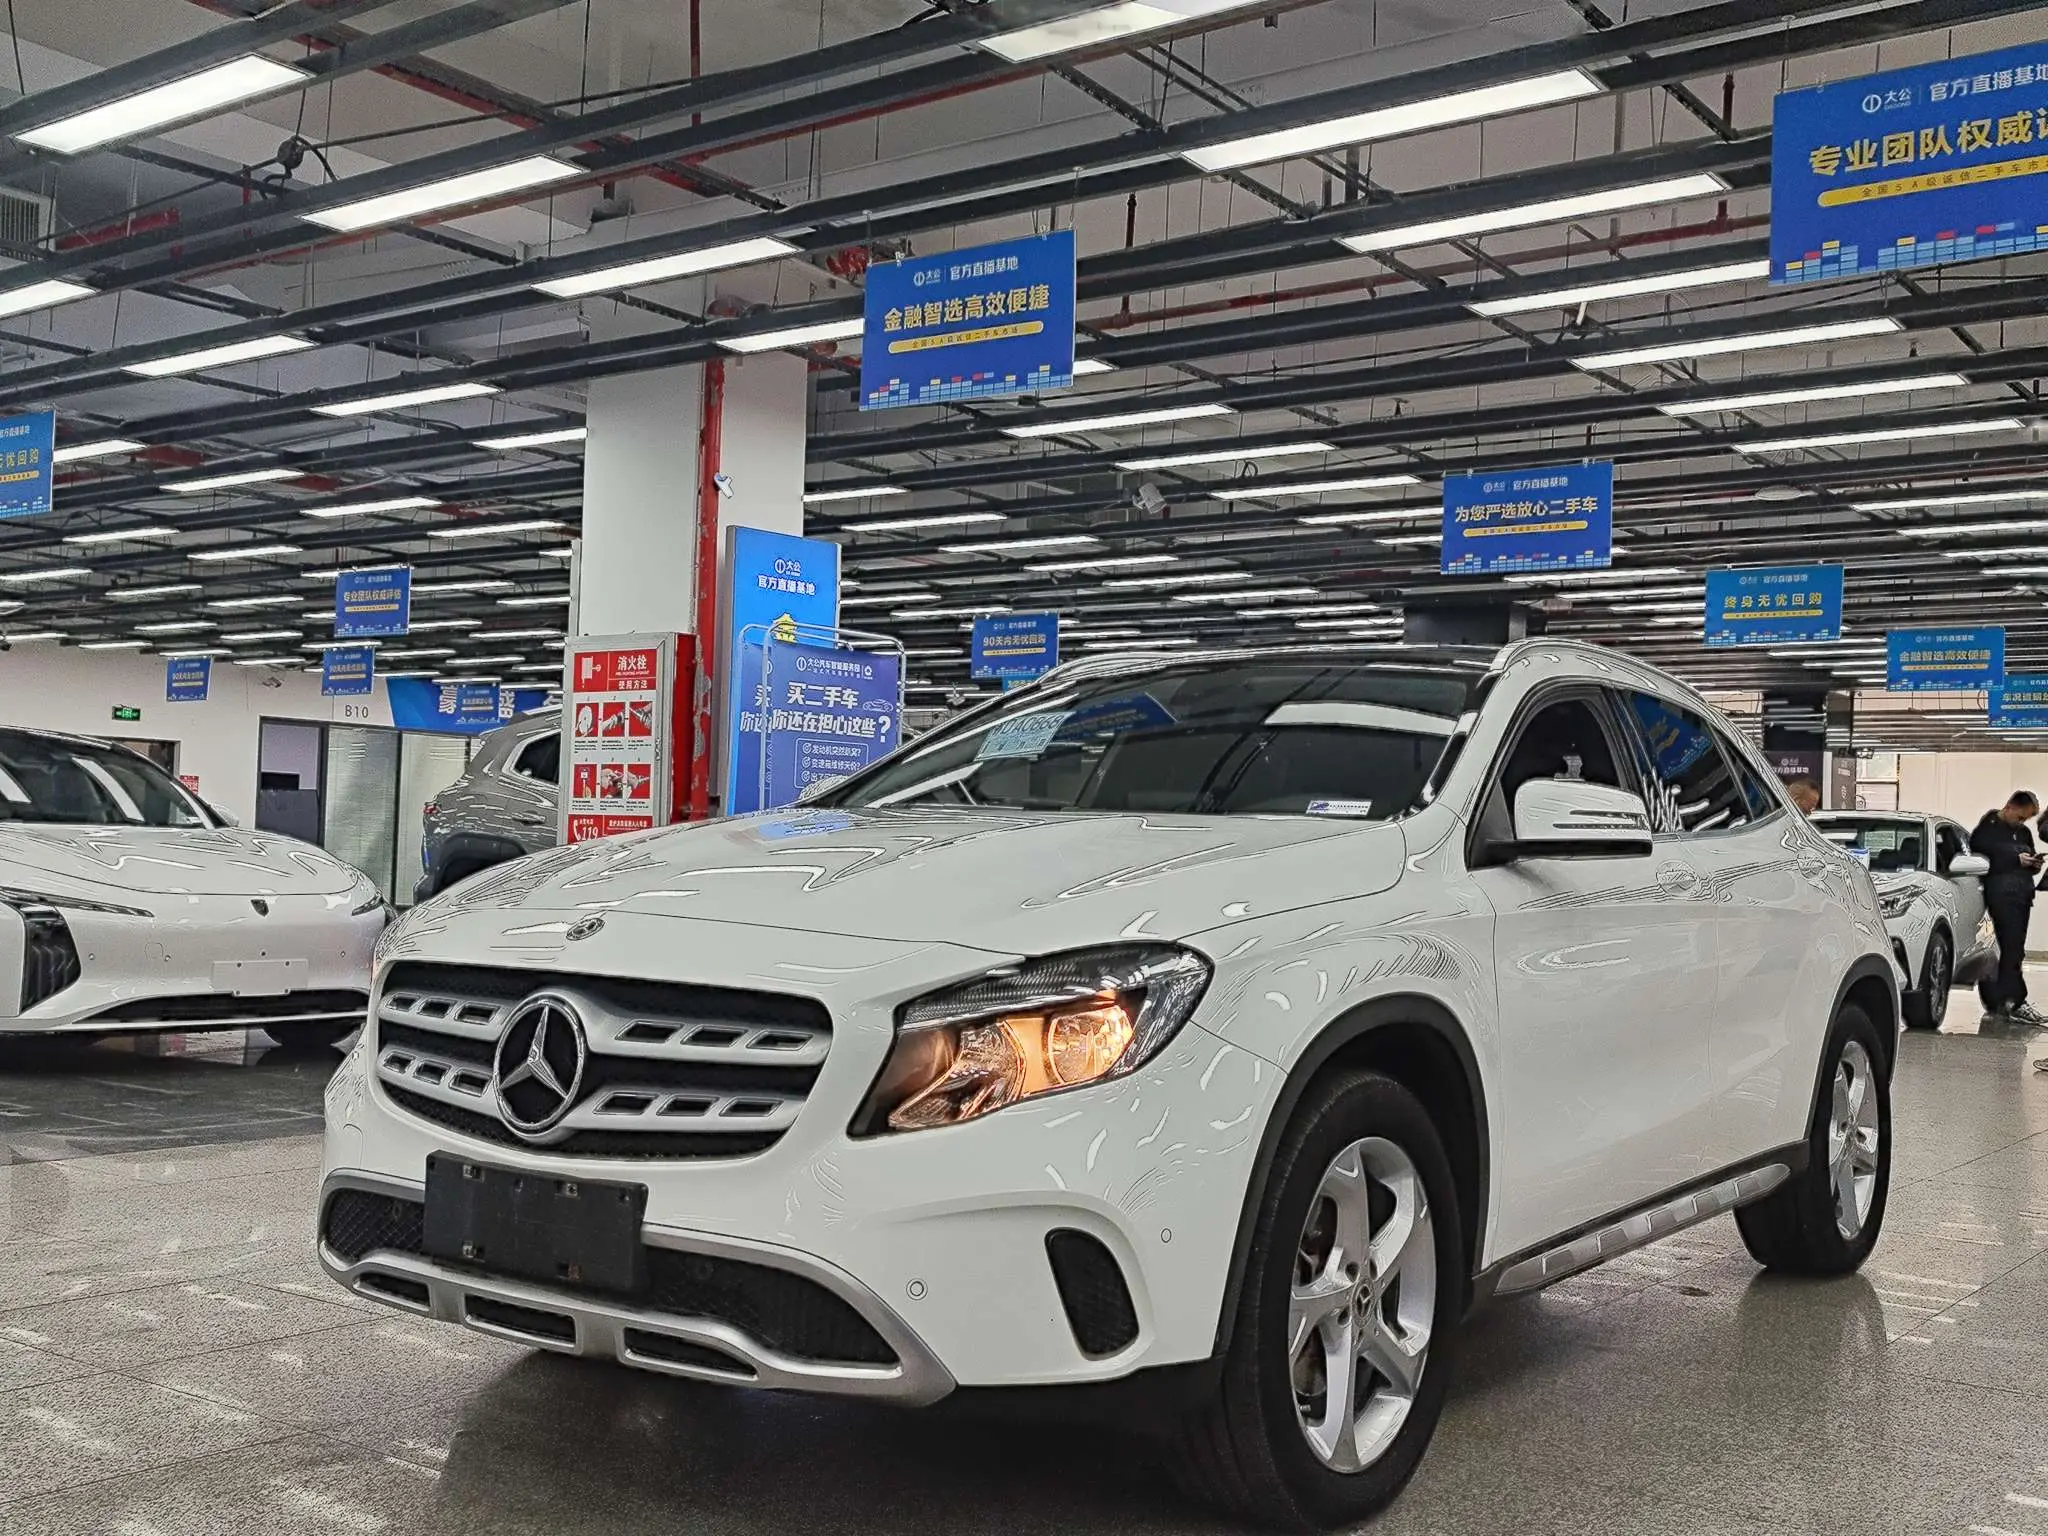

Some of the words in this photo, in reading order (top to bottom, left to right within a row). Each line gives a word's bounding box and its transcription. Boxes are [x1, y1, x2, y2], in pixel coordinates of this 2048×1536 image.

[1884, 88, 1912, 104] 大公
[950, 256, 1018, 281] 官方直播基地
[883, 284, 1050, 332] 金融智选高效便捷
[1513, 476, 1569, 491] 官方直播基地
[1455, 496, 1599, 523] 为您严选放心二手车
[786, 560, 801, 572] 大公
[758, 574, 816, 596] 官方直播基地
[618, 654, 647, 671] 消火栓
[787, 681, 860, 709] 买二手车
[345, 704, 369, 719] B10
[581, 826, 599, 841] 119
